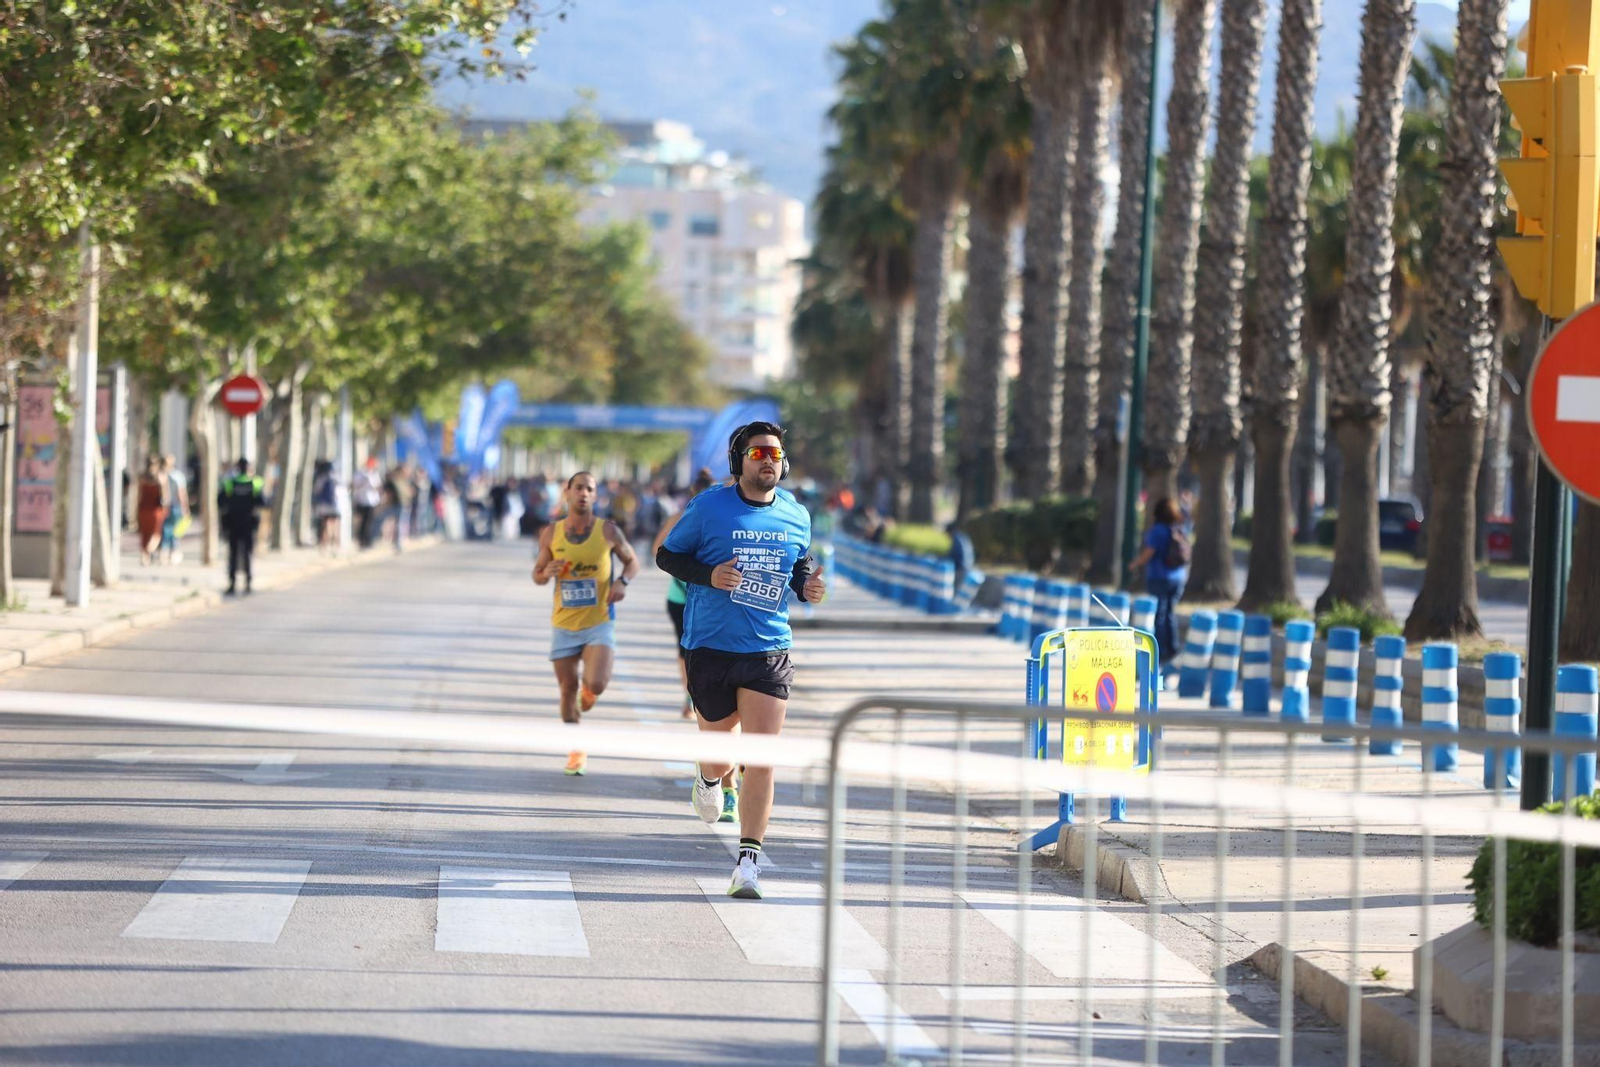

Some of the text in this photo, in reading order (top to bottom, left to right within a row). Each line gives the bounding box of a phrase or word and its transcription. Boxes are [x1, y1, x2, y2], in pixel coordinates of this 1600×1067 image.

[732, 529, 788, 542] mayoral
[738, 555, 781, 563] MAKES
[736, 562, 781, 571] FRIENDS
[740, 579, 779, 598] 2056
[565, 590, 592, 599] 1598
